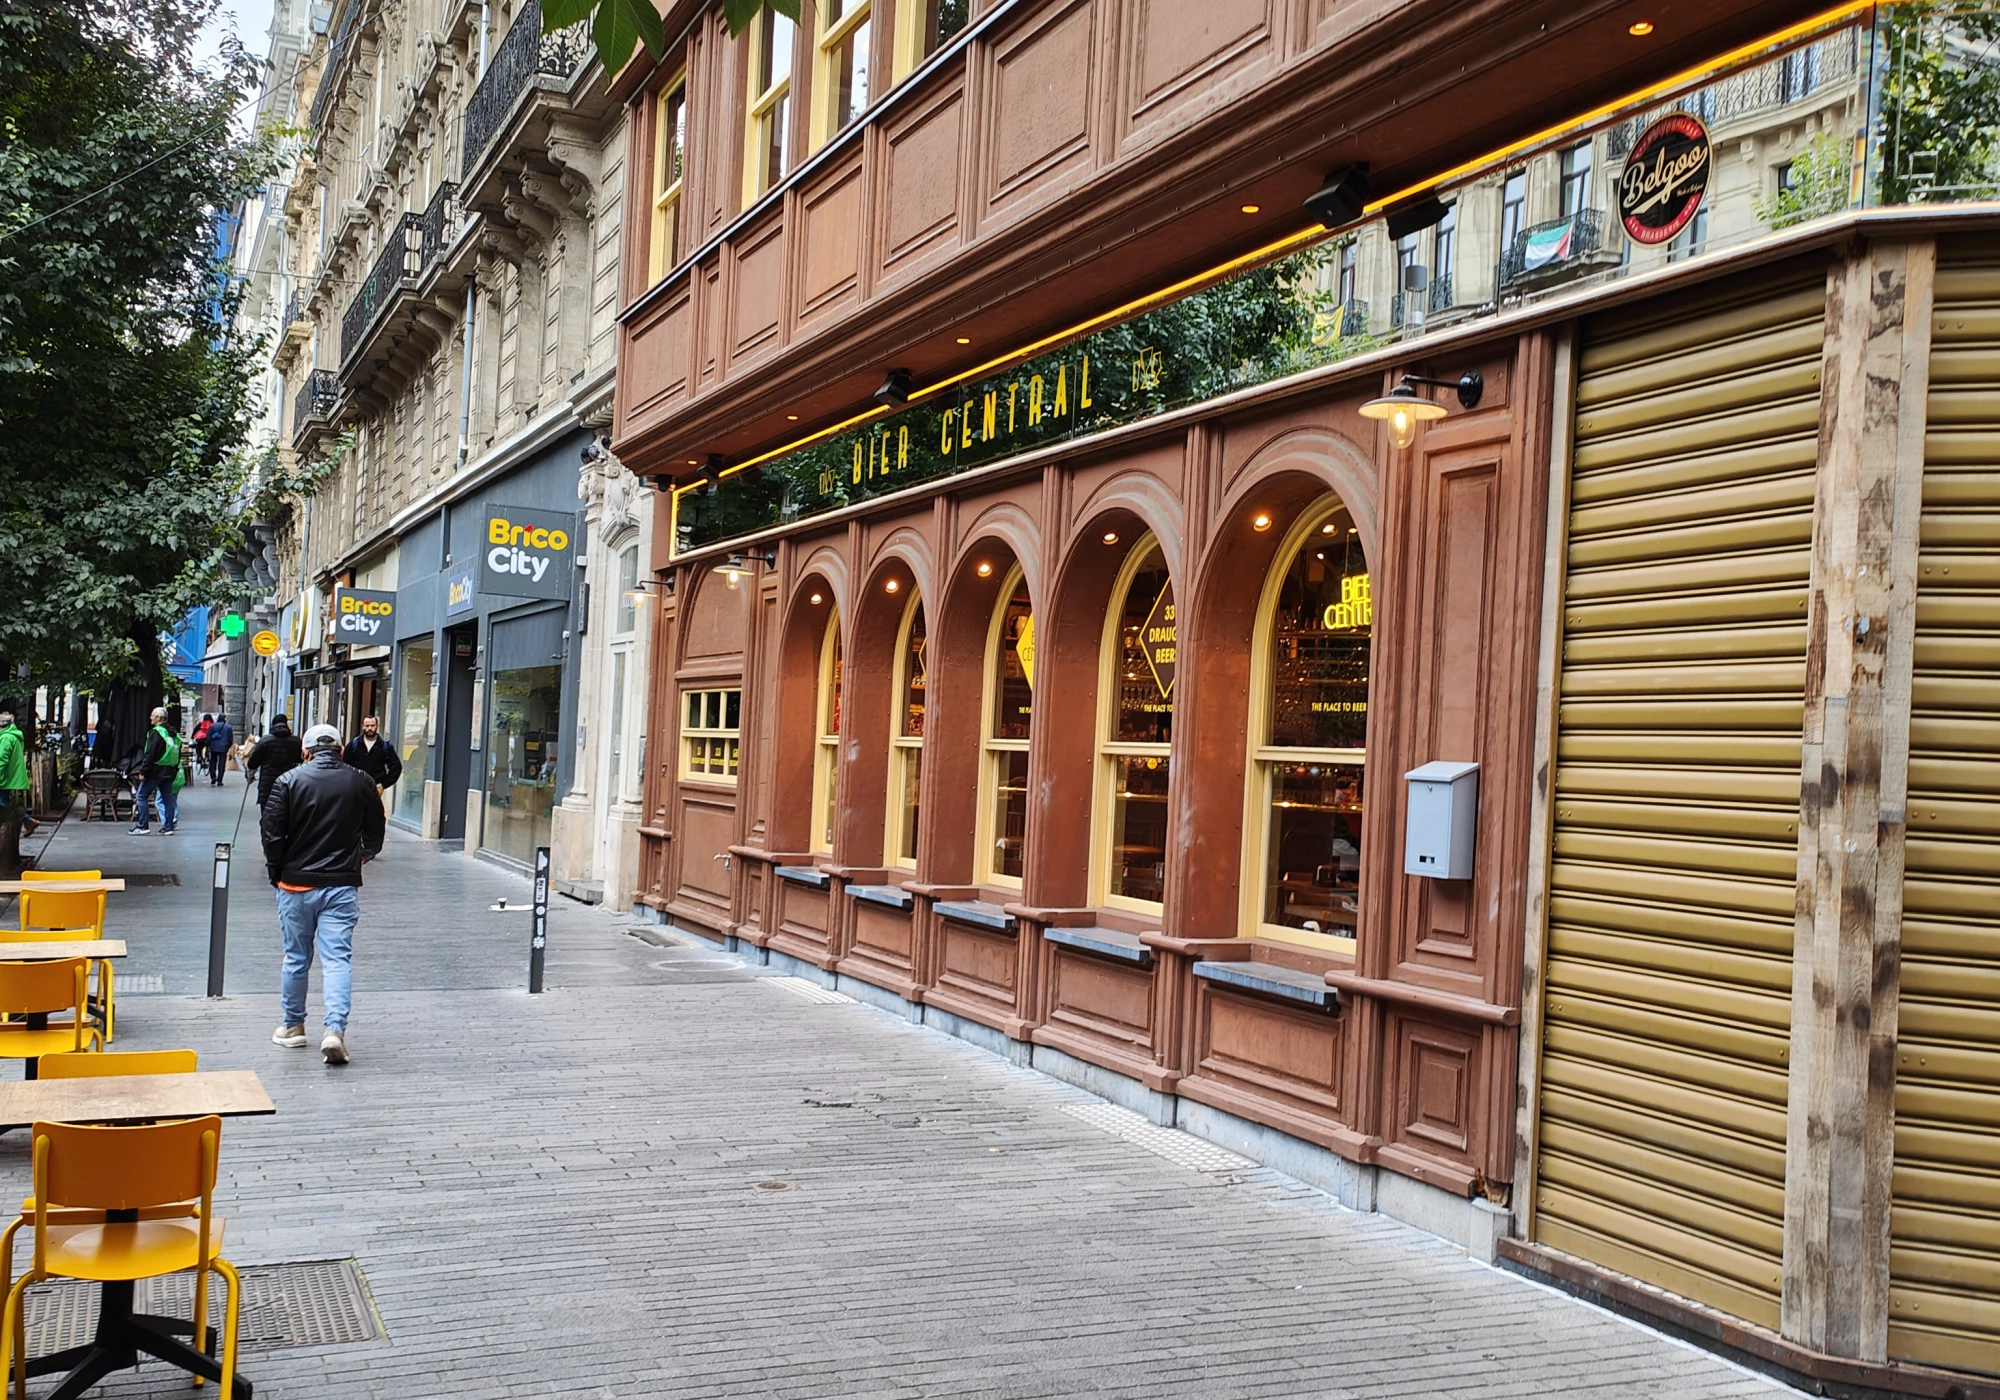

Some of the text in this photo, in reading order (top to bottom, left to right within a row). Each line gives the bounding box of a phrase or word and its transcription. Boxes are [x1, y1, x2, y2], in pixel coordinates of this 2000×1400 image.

[1622, 145, 1708, 208] Belgoo
[1641, 220, 1681, 240] BRASSERIE
[852, 355, 1093, 485] BIER CENTRAL
[489, 518, 568, 550] Brico
[488, 547, 550, 582] City
[340, 596, 393, 616] Brico
[340, 614, 381, 636] City
[1311, 702, 1367, 712] THE PLACE TO BEER
